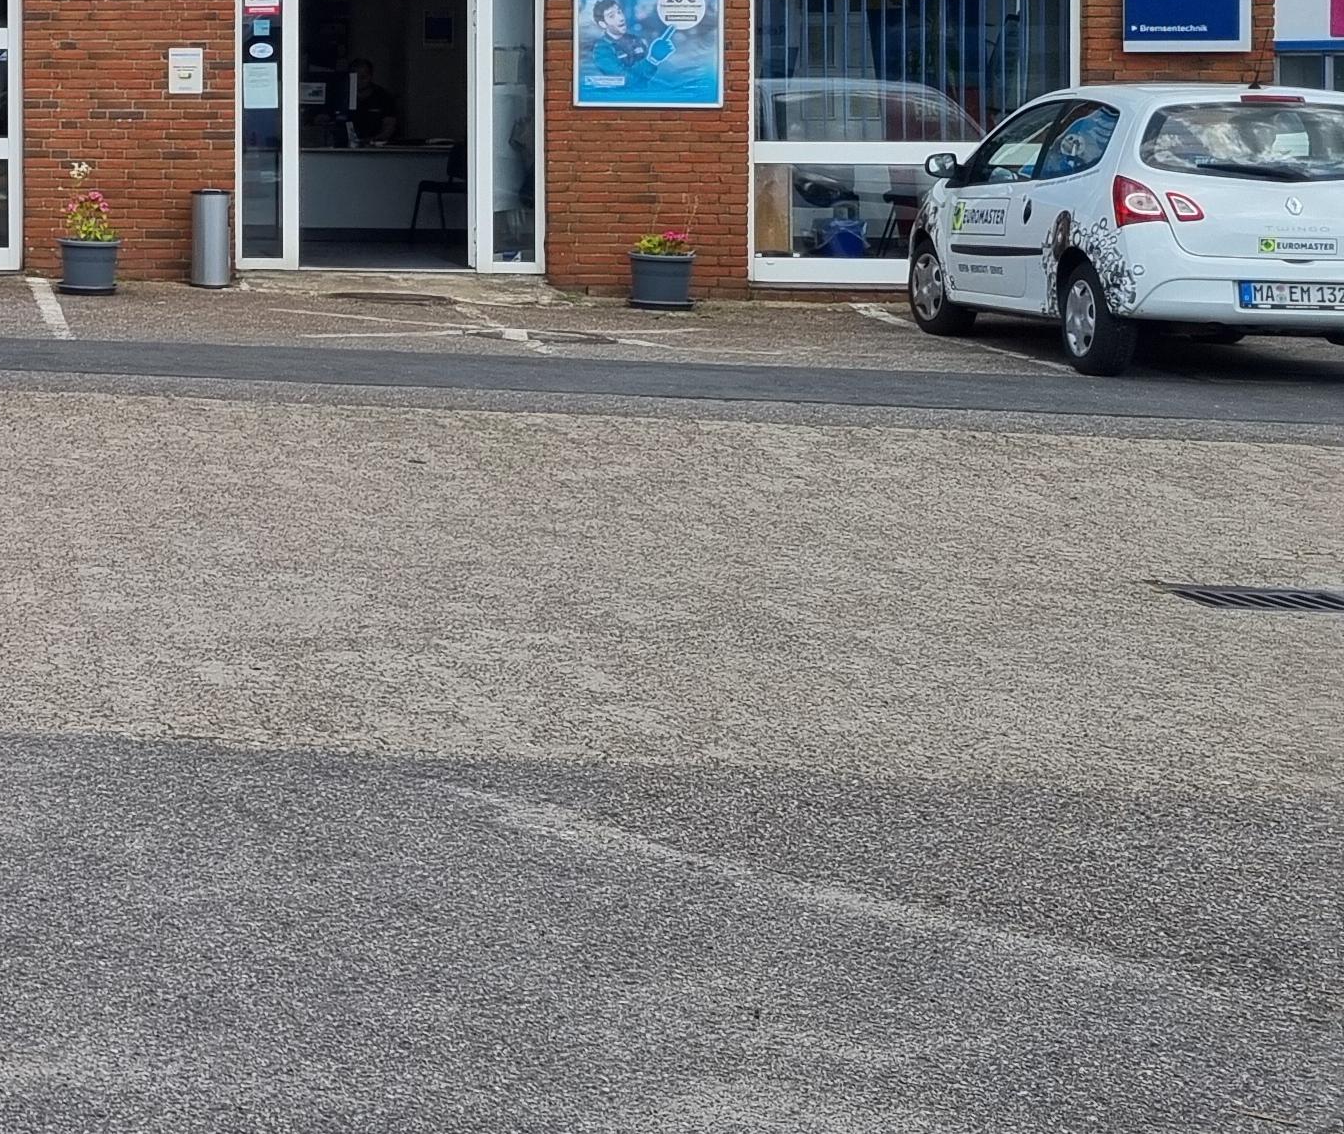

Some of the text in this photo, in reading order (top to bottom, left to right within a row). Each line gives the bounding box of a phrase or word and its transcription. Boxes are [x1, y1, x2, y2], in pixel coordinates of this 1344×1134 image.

[1139, 24, 1208, 32] Bremsentechnik
[962, 209, 1005, 225] EUROMASTER
[1264, 225, 1331, 233] TWINGO
[1276, 242, 1335, 251] EUROMASTER
[1252, 284, 1275, 302] MA
[1288, 285, 1311, 303] EM
